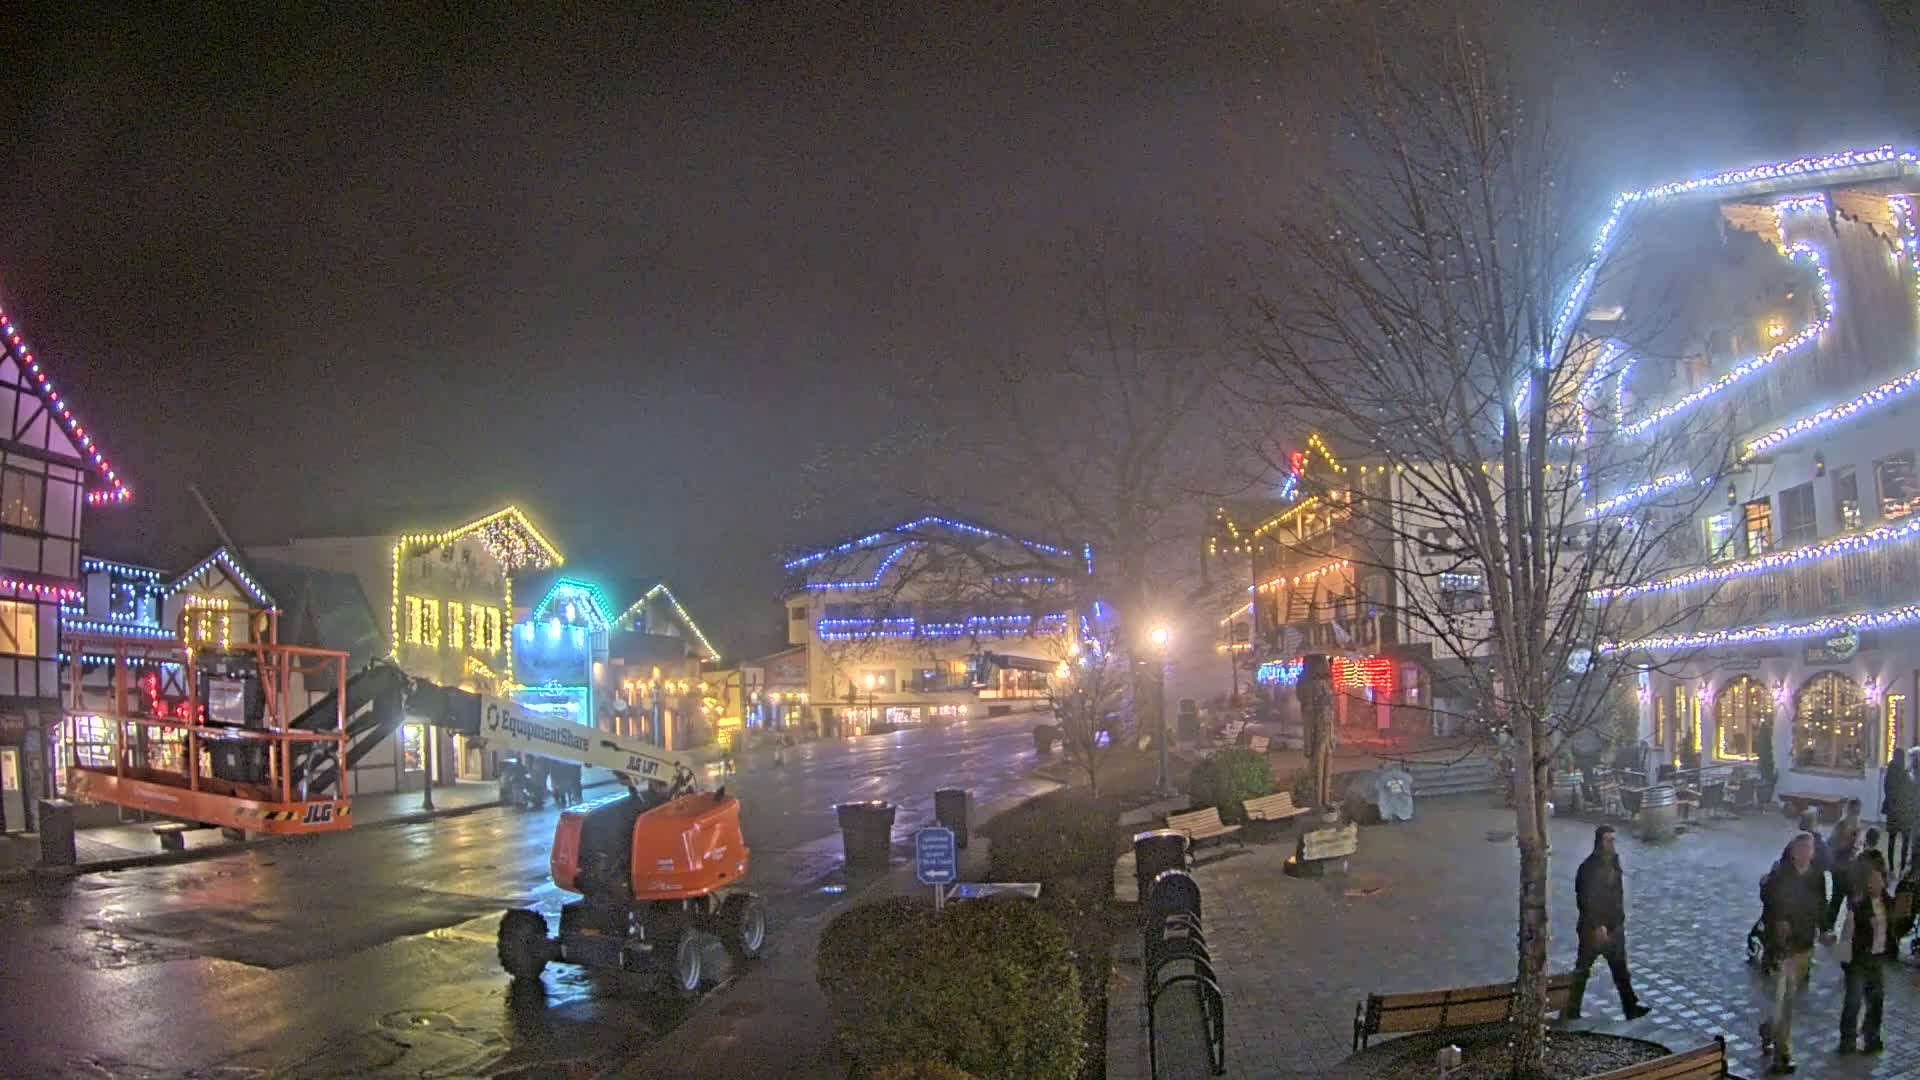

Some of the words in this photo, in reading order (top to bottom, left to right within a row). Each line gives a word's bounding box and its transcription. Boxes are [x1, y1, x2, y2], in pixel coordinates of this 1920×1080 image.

[502, 709, 590, 752] EquipmentShare
[626, 755, 642, 772] JLG
[642, 759, 660, 776] LIFT
[303, 802, 333, 824] JLG
